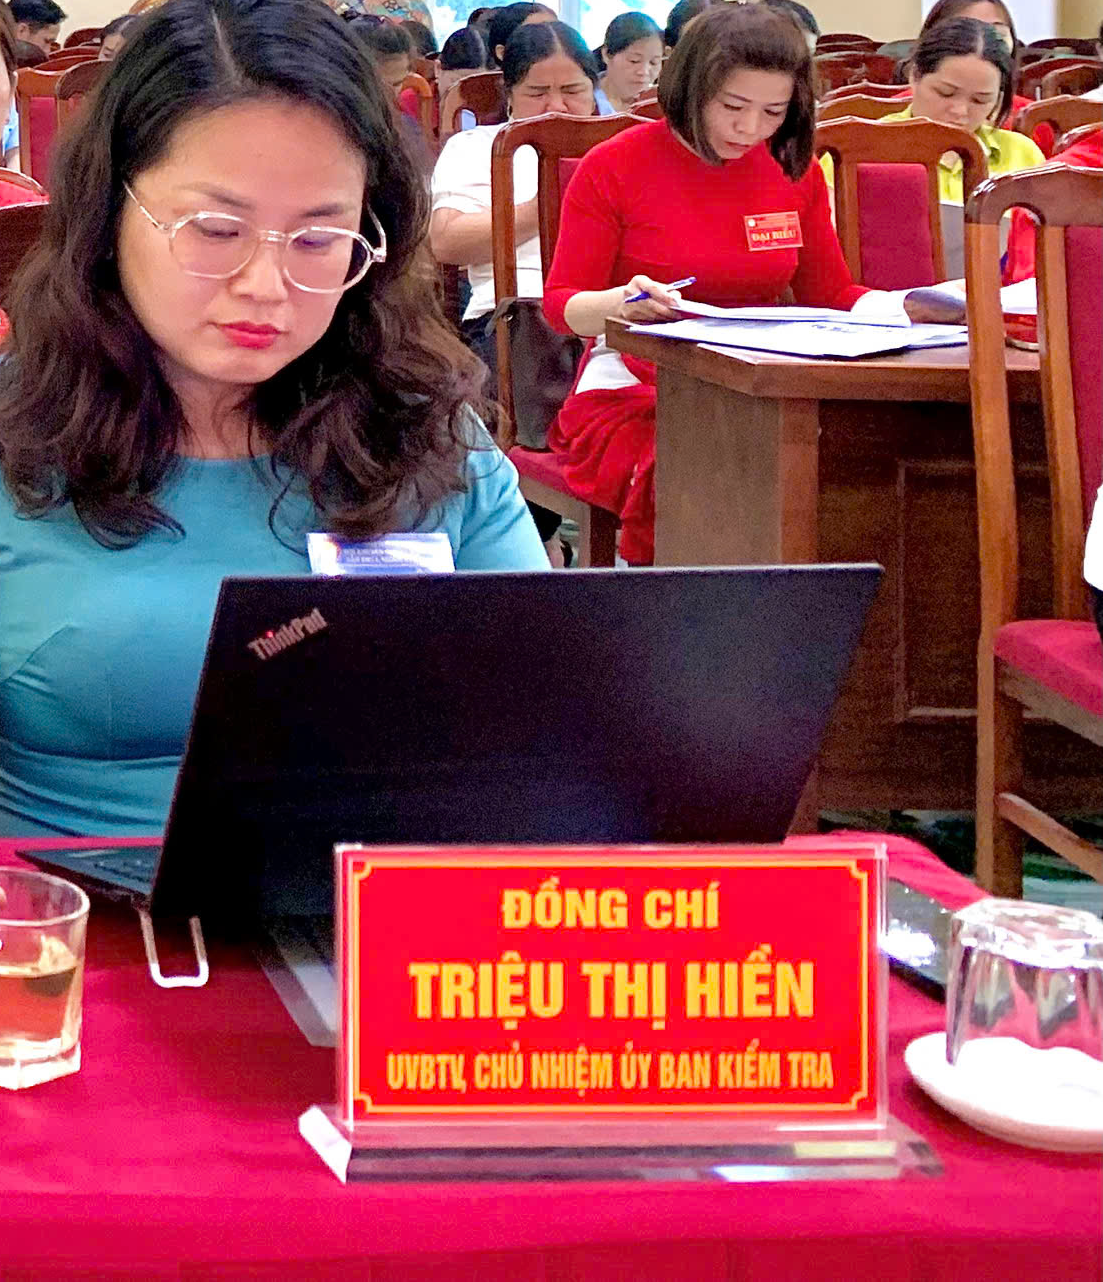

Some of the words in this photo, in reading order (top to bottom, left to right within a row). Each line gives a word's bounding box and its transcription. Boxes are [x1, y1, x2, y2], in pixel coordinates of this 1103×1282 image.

[247, 608, 328, 661] ThinkPad
[502, 876, 629, 929] ĐỒNG
[643, 881, 720, 929] CHÍ
[408, 950, 564, 1031] TRIỆU
[581, 962, 666, 1031] THỊ
[387, 1053, 467, 1094] UVBTV,
[474, 1040, 524, 1090] CHỦ
[531, 1044, 613, 1098] NHIỆM
[620, 1040, 652, 1089] ỦY
[659, 1052, 711, 1089] BAN
[718, 1038, 781, 1089] KIỂM
[787, 1052, 834, 1089] TRA
